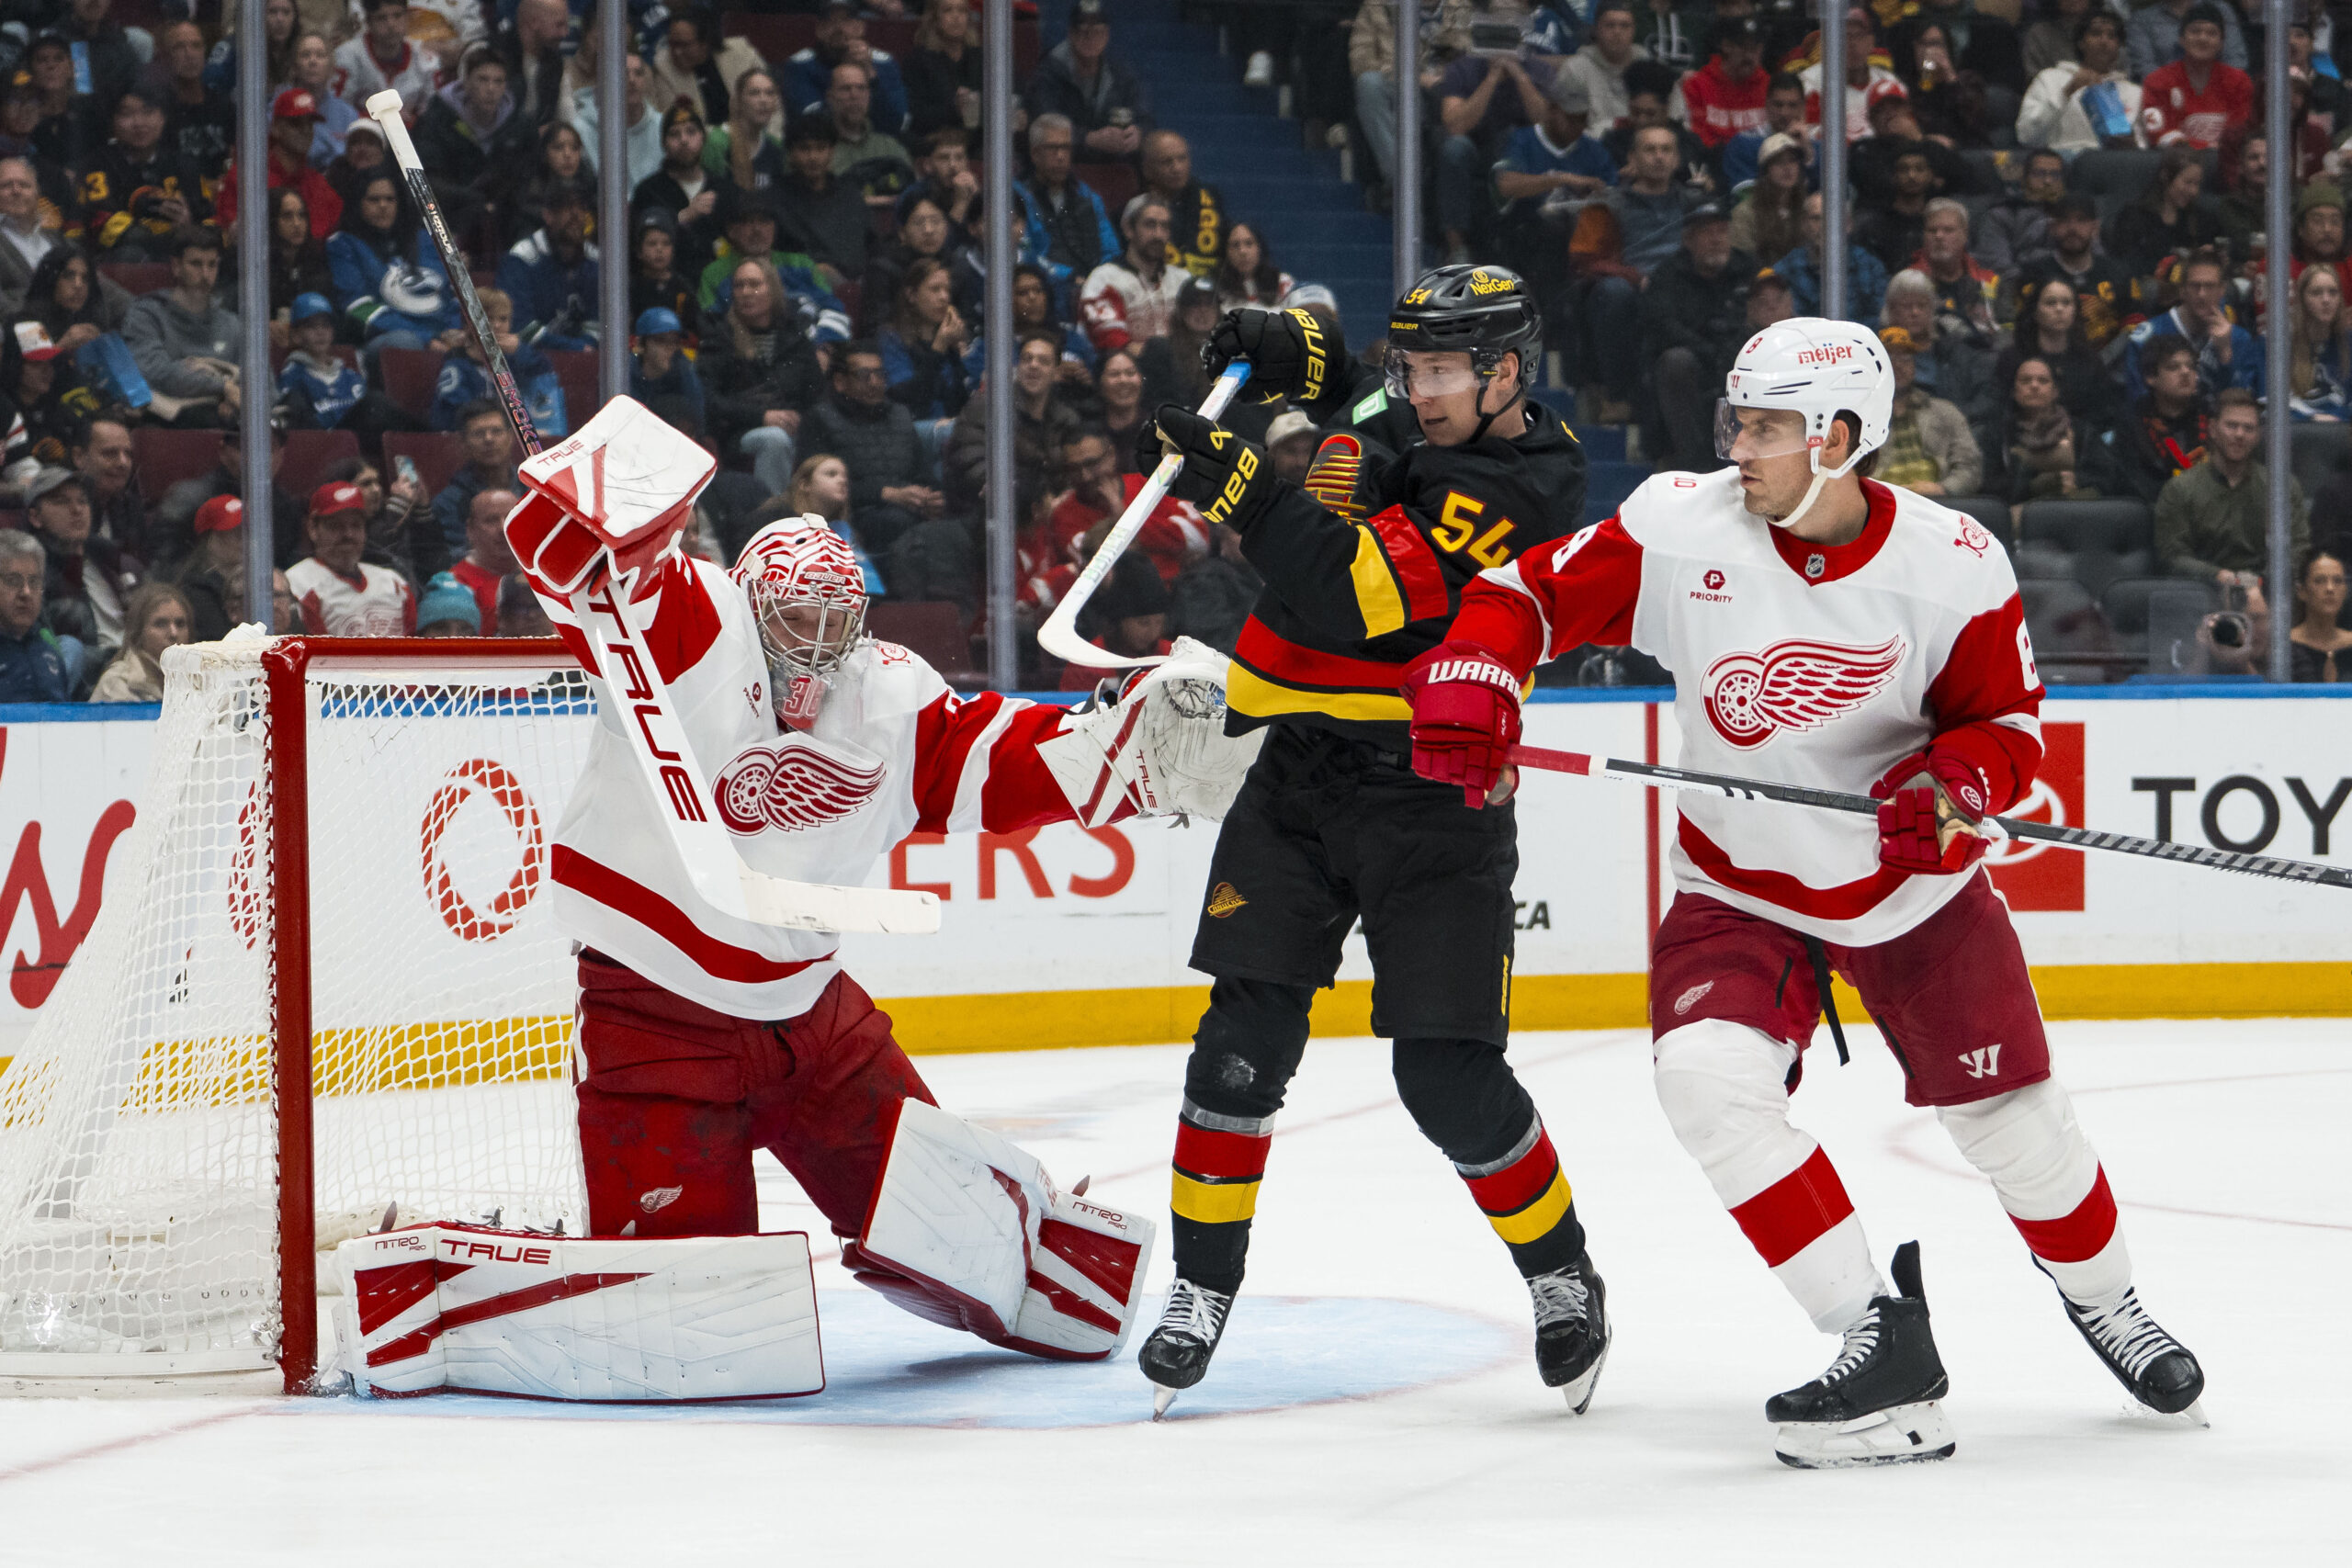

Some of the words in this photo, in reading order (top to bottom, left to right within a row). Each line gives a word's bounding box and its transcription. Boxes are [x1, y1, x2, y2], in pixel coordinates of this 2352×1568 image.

[1406, 288, 1432, 305] 54
[1470, 278, 1514, 296] NexGen
[1390, 321, 1419, 331] BAUER
[1746, 337, 1763, 354] 8
[1796, 343, 1852, 365] meijer
[536, 439, 584, 467] TRUE
[1430, 490, 1517, 570] 54
[804, 571, 846, 585] BAUER
[1690, 591, 1733, 604] PRIORITY
[1427, 660, 1523, 709] WARRI
[587, 584, 708, 823] TRUE
[1136, 749, 1159, 808] TRUE
[2131, 774, 2352, 856] TOY
[1072, 1201, 1124, 1223] NITRO
[375, 1235, 420, 1251] NITRO
[440, 1238, 552, 1266] TRUE
